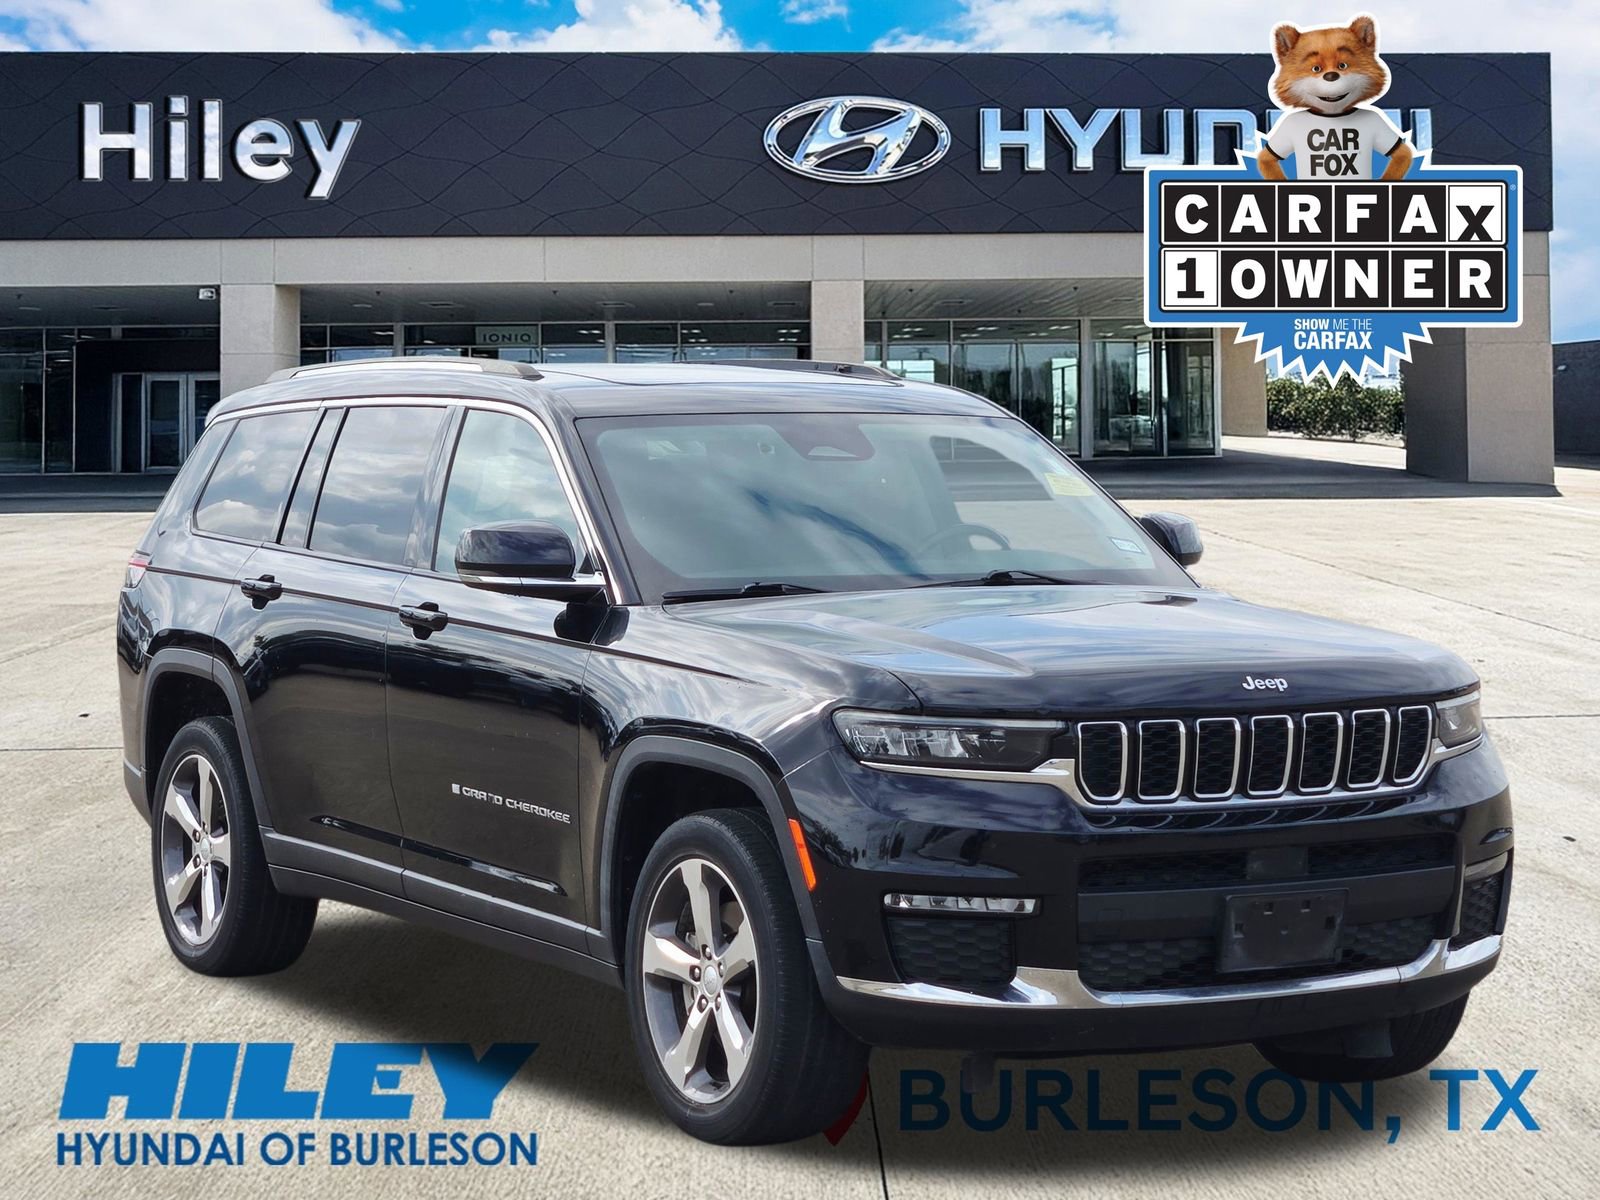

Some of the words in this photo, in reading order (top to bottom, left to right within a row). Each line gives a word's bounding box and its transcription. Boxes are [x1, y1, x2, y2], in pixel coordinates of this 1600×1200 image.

[79, 95, 361, 200] Hiley
[978, 107, 1432, 172] HYUNI
[483, 332, 532, 343] IONIQ
[1242, 675, 1288, 692] Jeep
[505, 798, 571, 824] CHEROKEE
